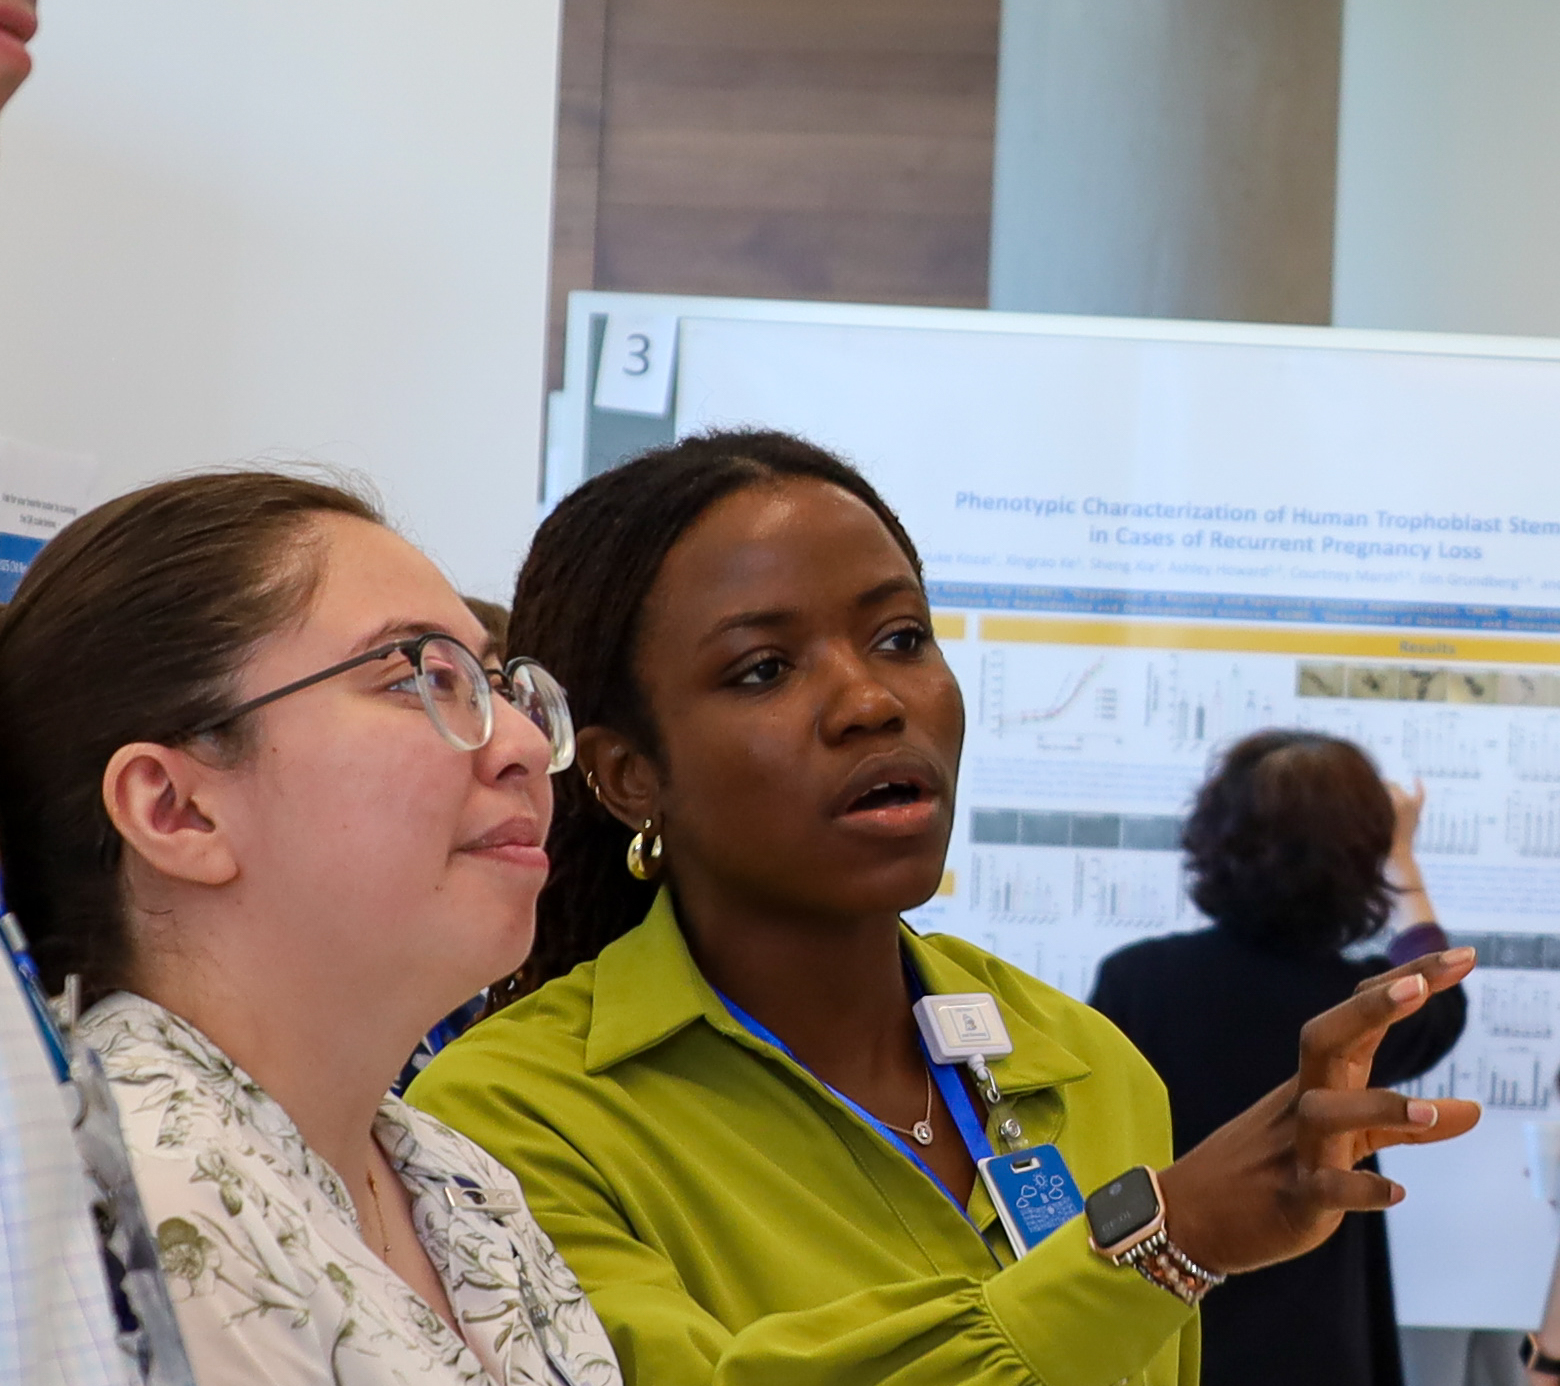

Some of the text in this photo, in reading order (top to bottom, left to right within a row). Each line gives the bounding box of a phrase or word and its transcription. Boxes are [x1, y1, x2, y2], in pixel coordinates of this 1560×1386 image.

[623, 332, 651, 377] 3
[955, 491, 1076, 517] Phenotypic
[1081, 495, 1257, 522] Characterization
[1263, 504, 1287, 524] of
[1292, 506, 1368, 528] Human
[1376, 509, 1501, 534] Trophoblast
[1089, 525, 1483, 562] in Cases of Recurrent Pregnancy Loss
[1399, 640, 1457, 657] Results
